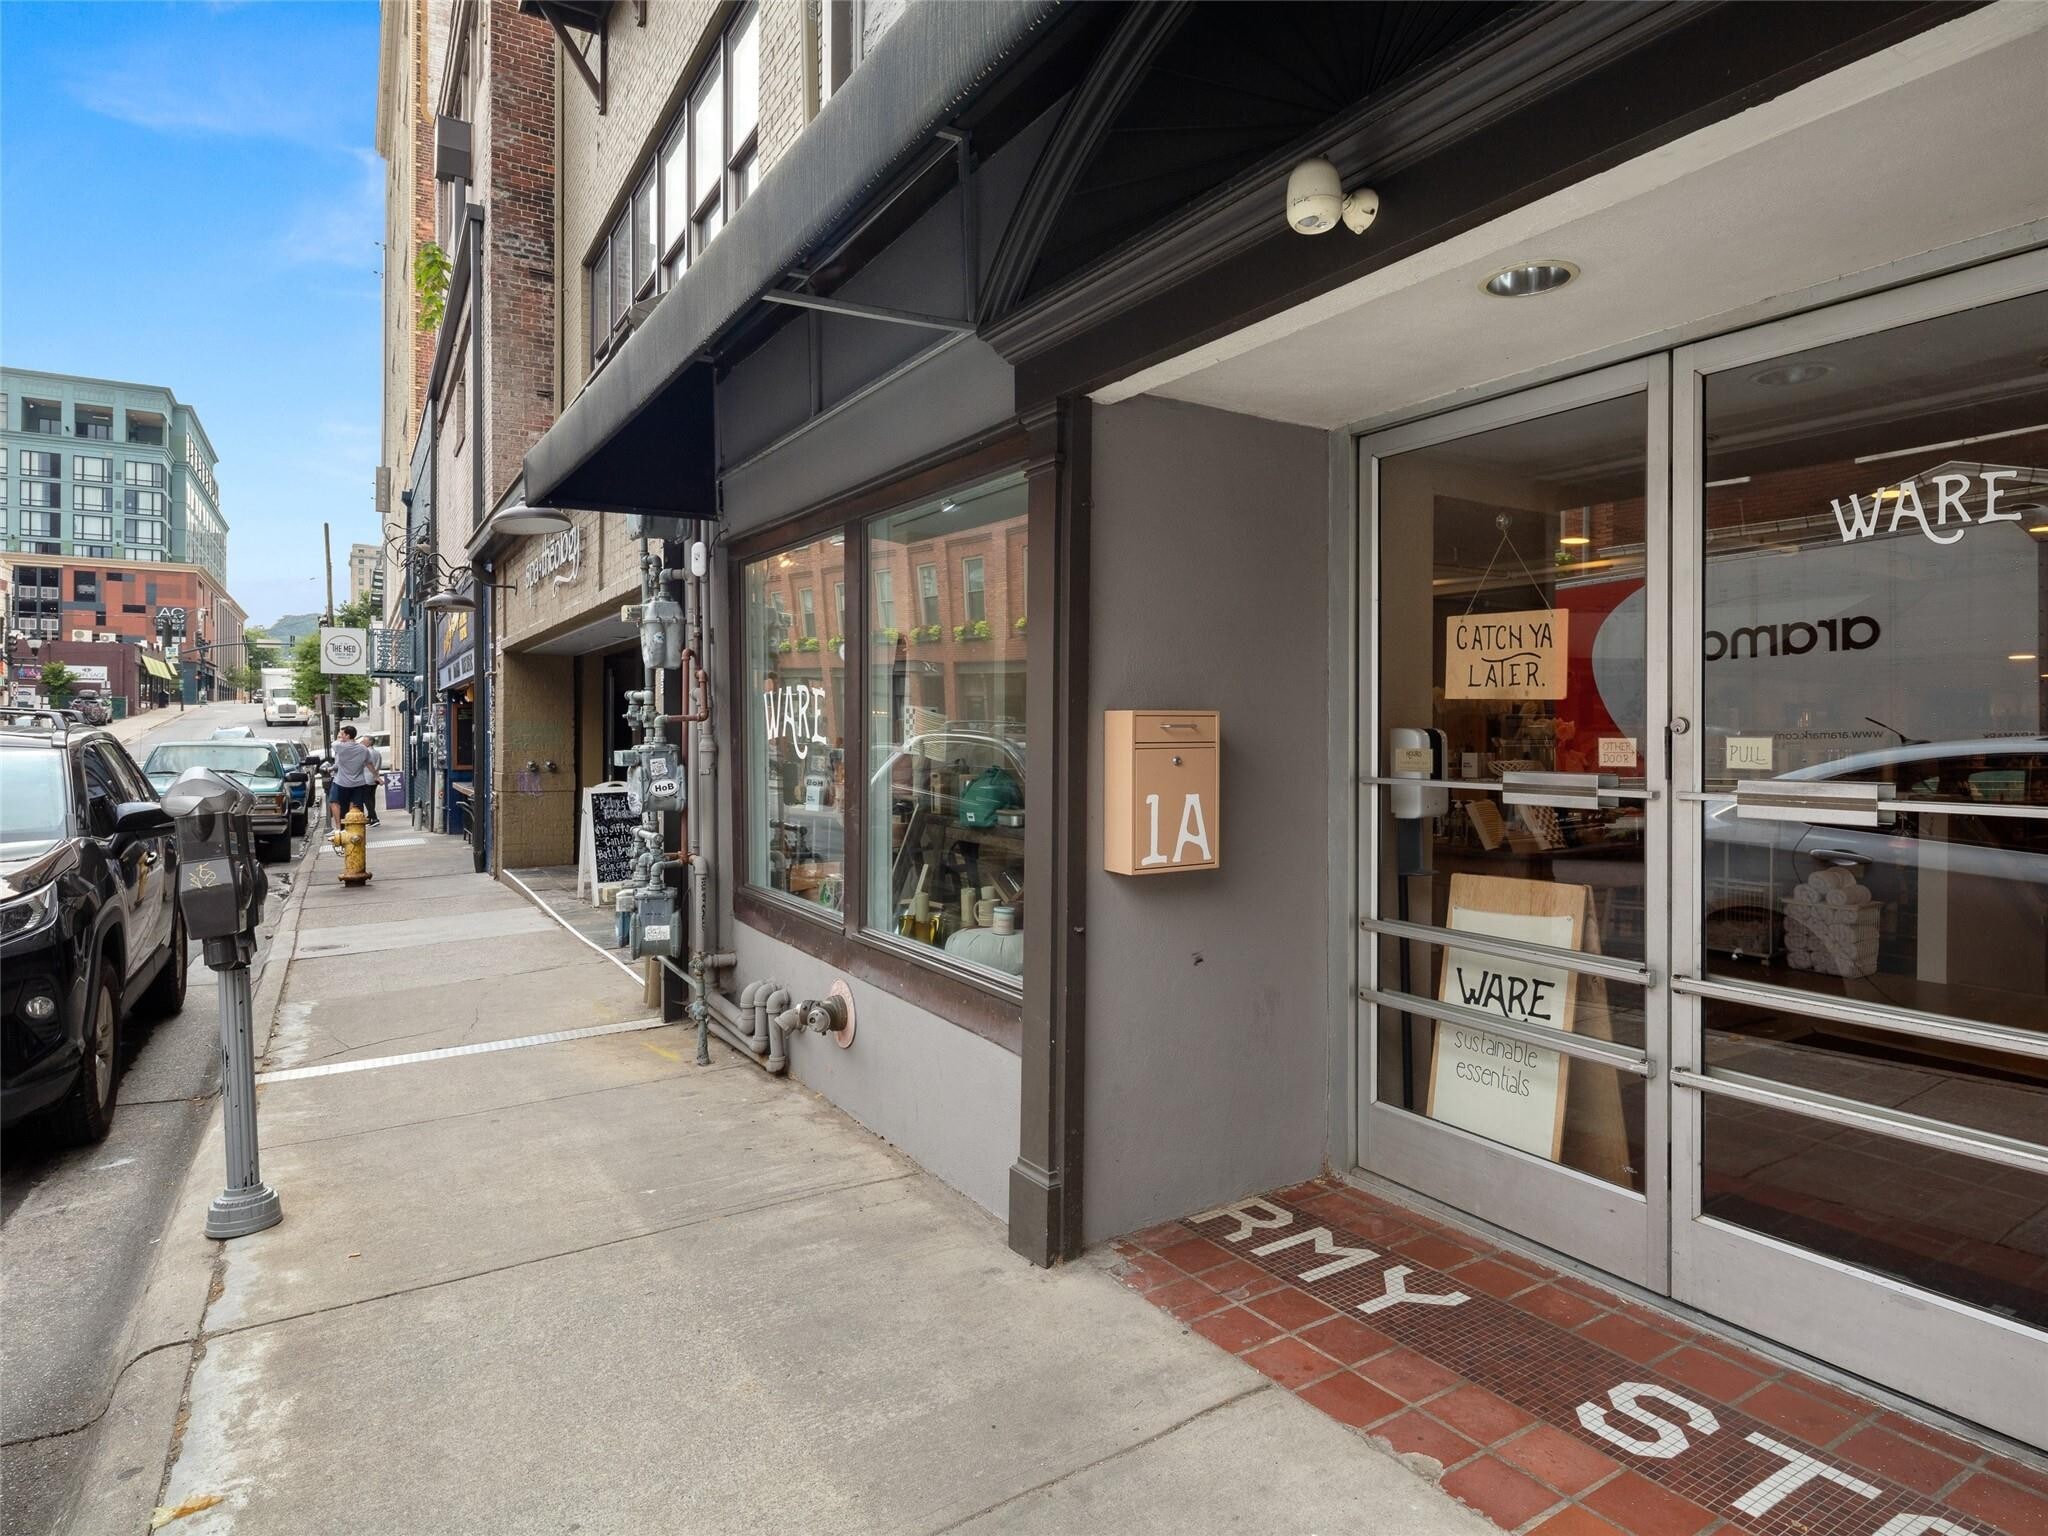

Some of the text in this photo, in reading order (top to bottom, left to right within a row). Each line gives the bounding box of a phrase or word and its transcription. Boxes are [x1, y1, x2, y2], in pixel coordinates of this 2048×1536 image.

[1830, 470, 2023, 545] WARE
[329, 643, 342, 652] THE
[1456, 623, 1553, 651] CATCH YA
[763, 685, 827, 760] WARE
[1602, 742, 1632, 752] OTHER
[1602, 753, 1630, 764] DOOR
[1729, 744, 1769, 765] PULL
[654, 783, 675, 792] HoB
[604, 834, 632, 847] Candle
[1141, 793, 1212, 866] 1A
[1456, 967, 1556, 1022] WARE
[1454, 1031, 1538, 1069] sustainable
[1455, 1061, 1530, 1097] essentials
[1575, 1381, 1983, 1536] ST
